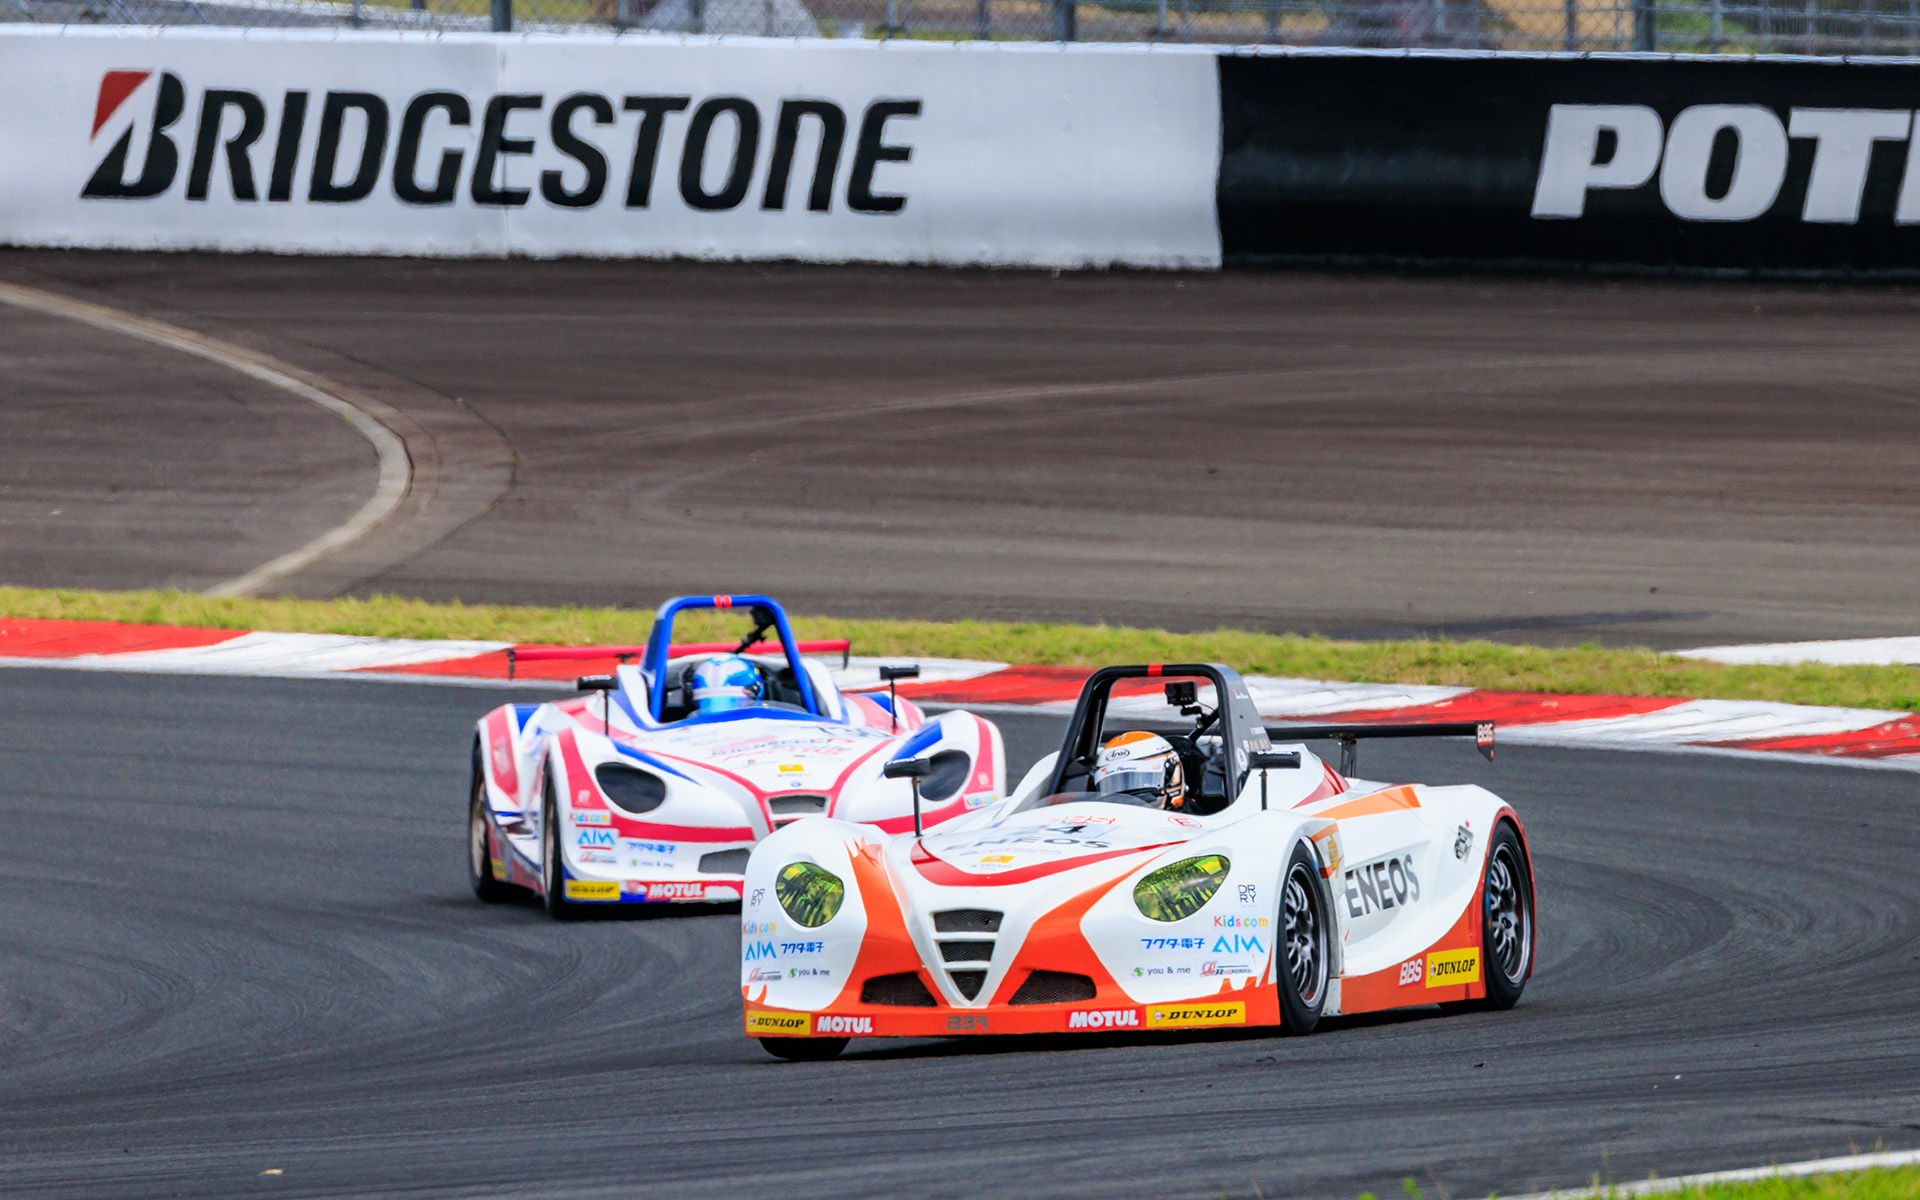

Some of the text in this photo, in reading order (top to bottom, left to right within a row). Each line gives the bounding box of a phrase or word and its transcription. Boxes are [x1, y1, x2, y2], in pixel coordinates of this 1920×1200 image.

[80, 69, 922, 214] BRIDGESTONE
[1531, 103, 1920, 225] POT
[649, 883, 703, 898] MOTUL
[1345, 854, 1420, 918] ENEOS
[1213, 914, 1269, 928] Kids com
[744, 941, 777, 961] AIM
[1211, 934, 1265, 953] AIM
[1147, 967, 1164, 975] you
[1166, 966, 1173, 974] &
[1399, 959, 1423, 985] BBS
[1436, 958, 1476, 976] DUNLOP
[757, 1017, 805, 1028] DUNLOP
[1069, 1009, 1139, 1028] MOTUL
[1167, 1008, 1238, 1020] DUNLOP
[816, 1015, 873, 1033] MOTUL
